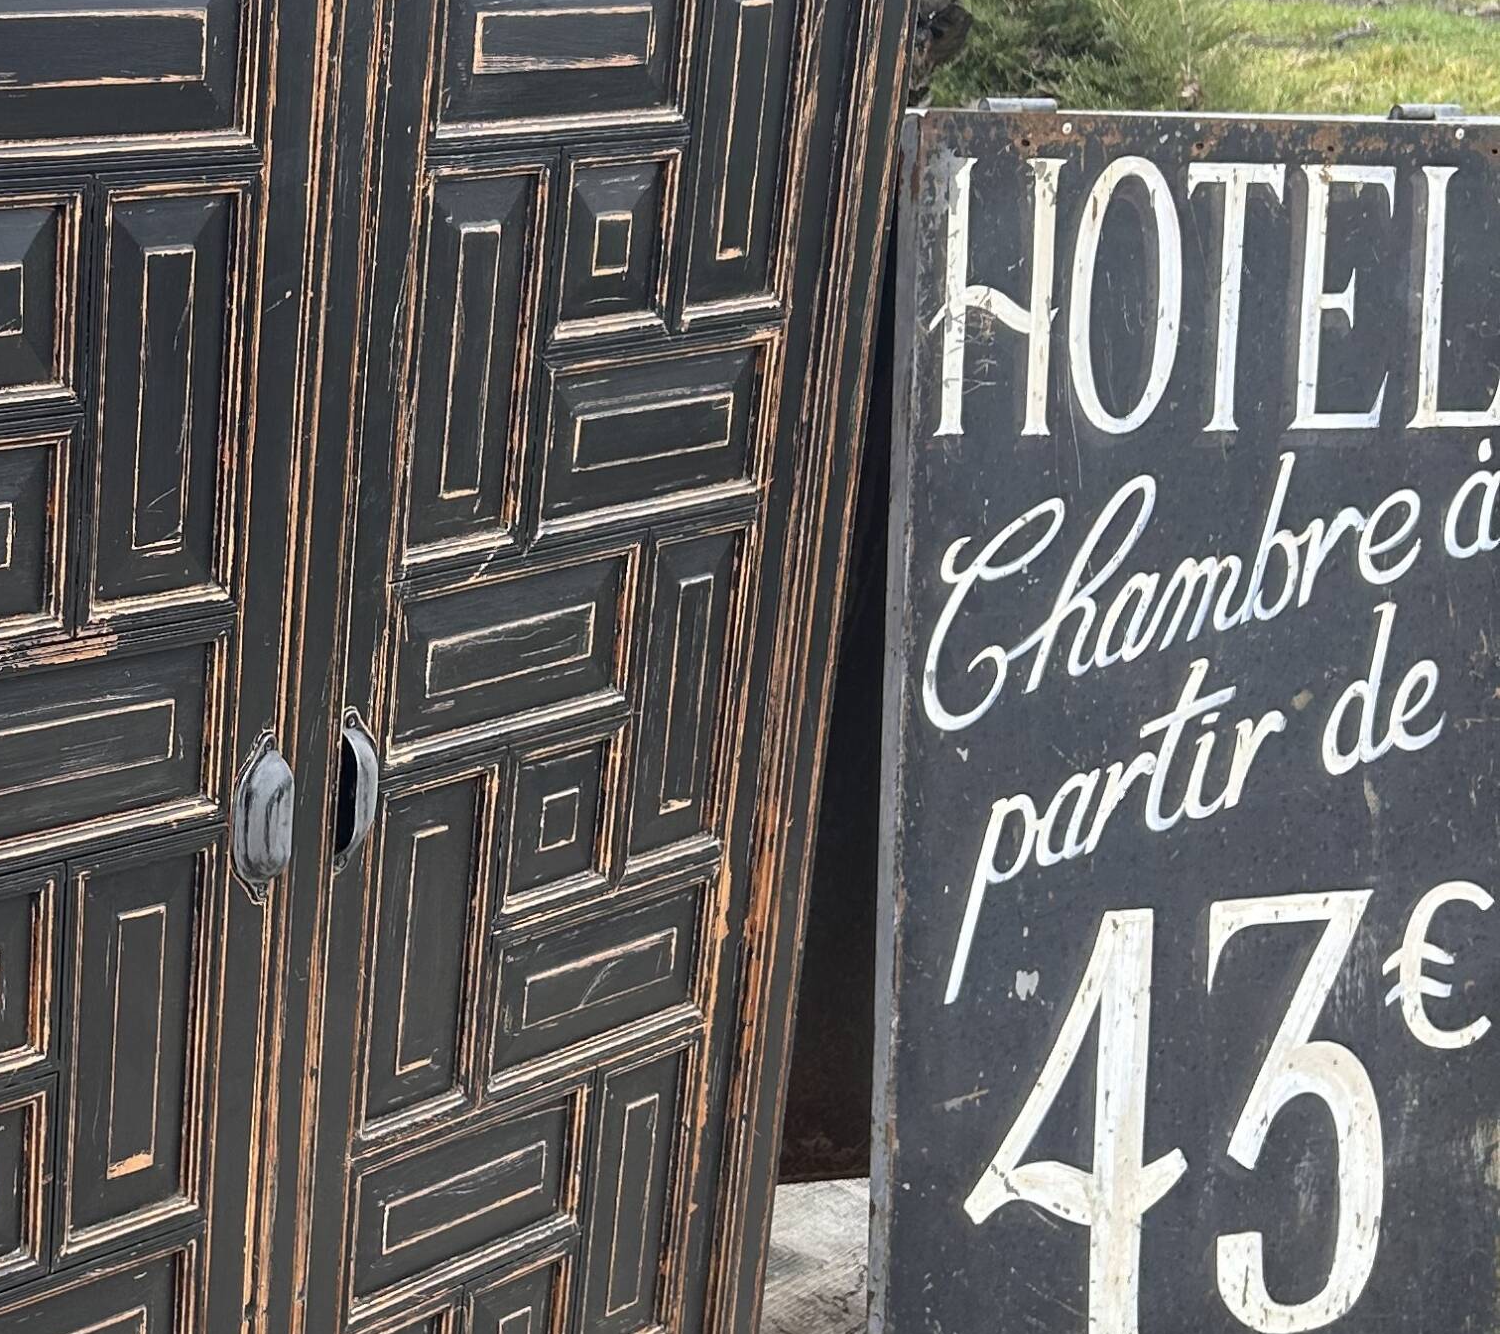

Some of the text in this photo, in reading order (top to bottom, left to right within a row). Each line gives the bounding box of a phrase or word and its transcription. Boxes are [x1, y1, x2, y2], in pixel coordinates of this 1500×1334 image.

[928, 154, 1500, 437] HOTEL
[922, 450, 1422, 732] Chambre
[943, 601, 1448, 1005] partir de
